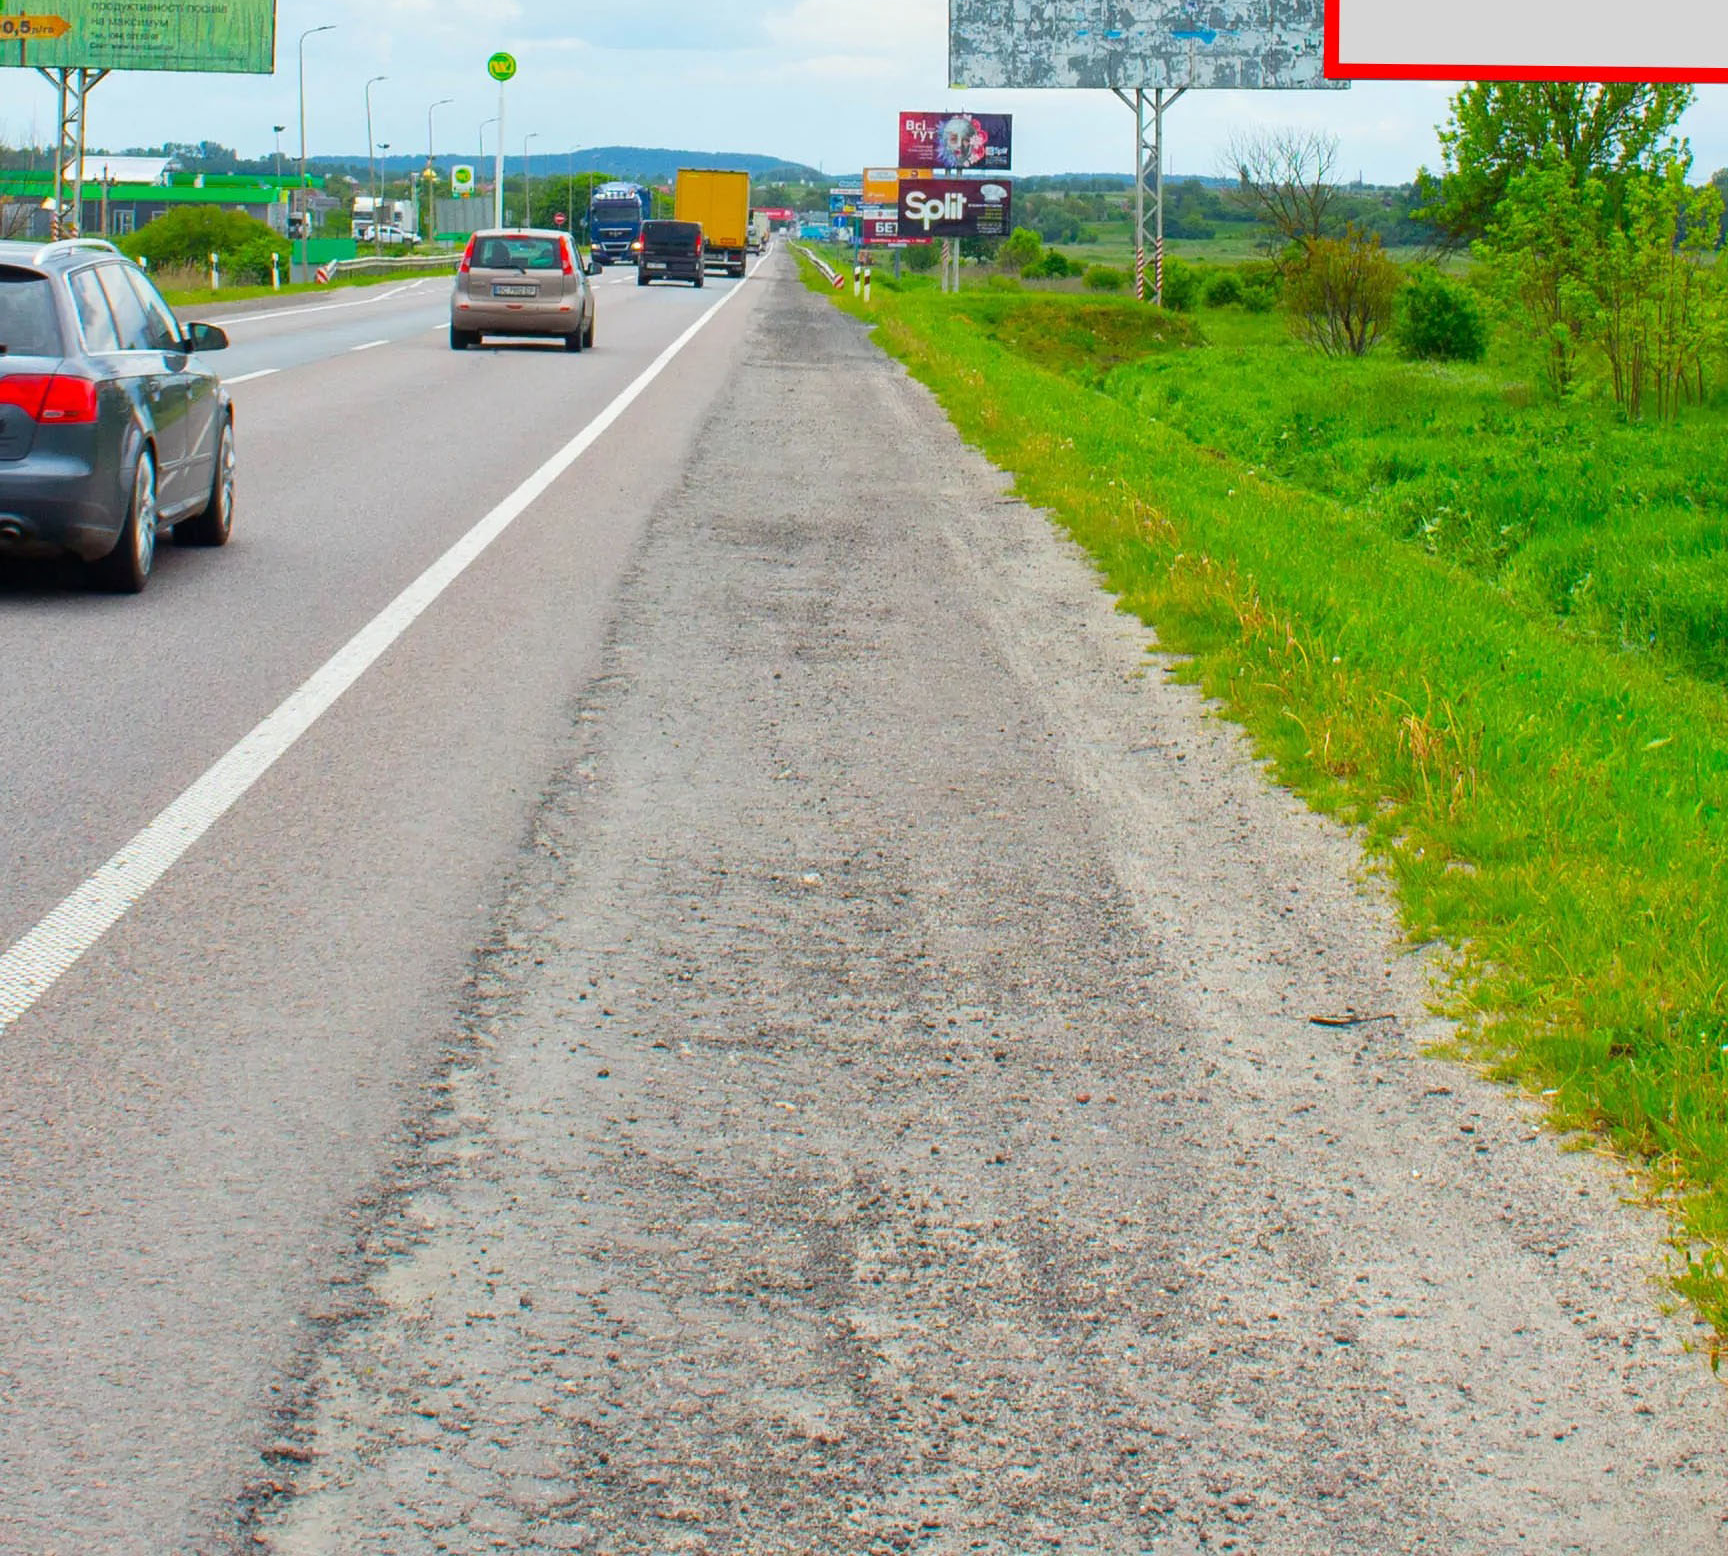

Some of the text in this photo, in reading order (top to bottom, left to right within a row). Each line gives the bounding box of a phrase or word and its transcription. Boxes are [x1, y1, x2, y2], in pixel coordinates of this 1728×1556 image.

[3, 20, 31, 36] 0,5
[905, 120, 926, 131] Всі
[905, 191, 968, 231] Split
